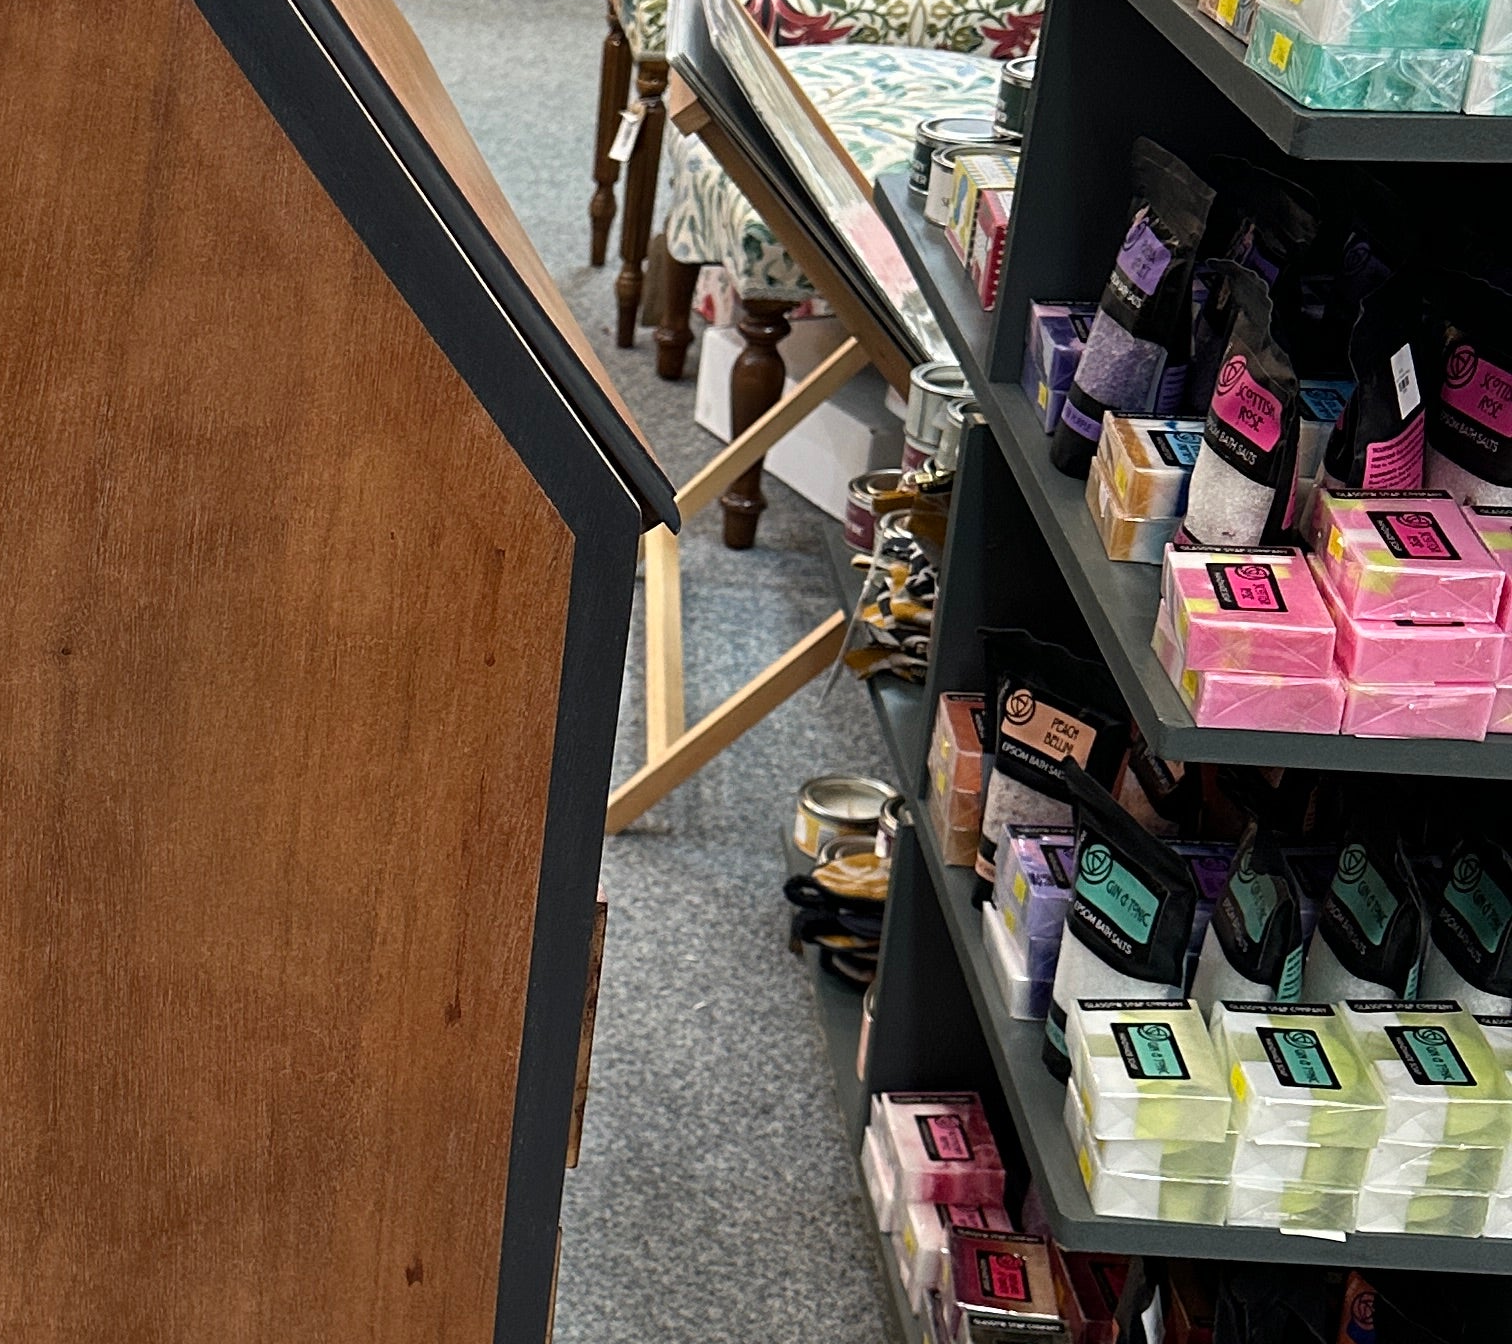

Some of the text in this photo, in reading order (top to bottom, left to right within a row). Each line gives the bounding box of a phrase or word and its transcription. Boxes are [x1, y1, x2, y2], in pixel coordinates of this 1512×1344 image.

[1235, 381, 1277, 421] SCOTTISH
[1477, 395, 1504, 420] ROSE
[1236, 405, 1264, 433] ROSE
[1219, 432, 1238, 451] BATH
[1235, 444, 1258, 466] SALTS
[1475, 433, 1499, 453] SALTS
[1050, 717, 1080, 740] PEACH
[1001, 741, 1029, 761] EPSOM
[1028, 755, 1049, 772] BATH
[1106, 879, 1123, 900] GIN
[1127, 898, 1152, 928] TONIC
[1073, 900, 1133, 955] EPSOM BATH SALTS
[1083, 1000, 1184, 1009] GLASGOW SOAP COMPANY
[1229, 1003, 1327, 1015] GLASGOW SOAP COMPANY
